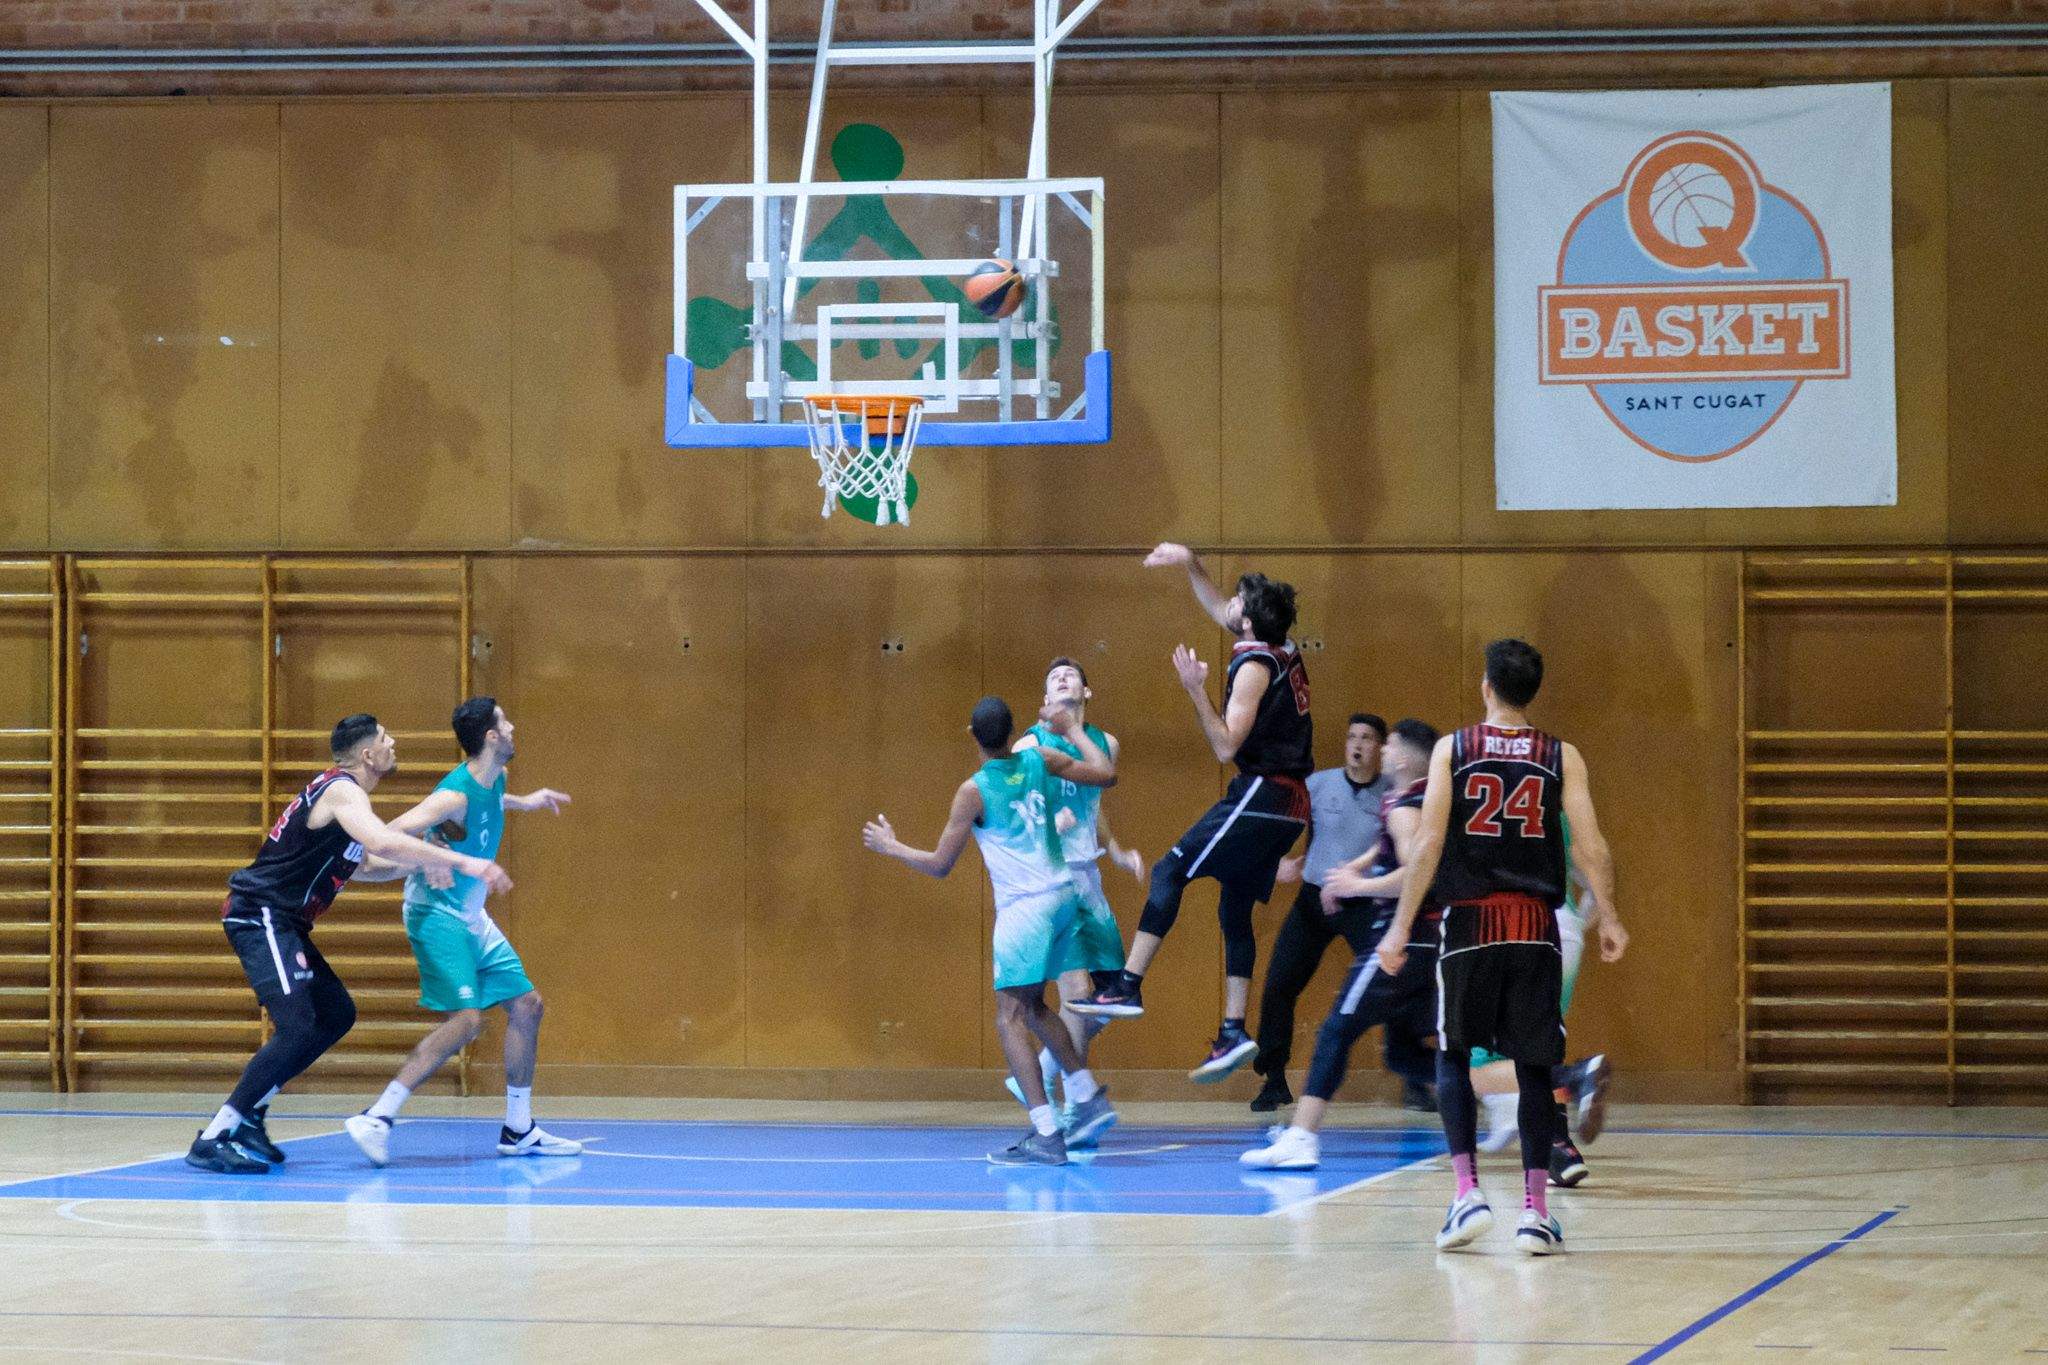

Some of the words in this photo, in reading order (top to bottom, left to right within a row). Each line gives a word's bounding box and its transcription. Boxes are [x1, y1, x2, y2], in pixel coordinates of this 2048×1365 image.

[1628, 141, 1756, 269] Q
[1558, 302, 1830, 359] BASKET
[1625, 395, 1683, 411] SANT
[1693, 393, 1766, 409] CUGAT
[1484, 735, 1531, 755] REYES
[1464, 772, 1546, 838] 24
